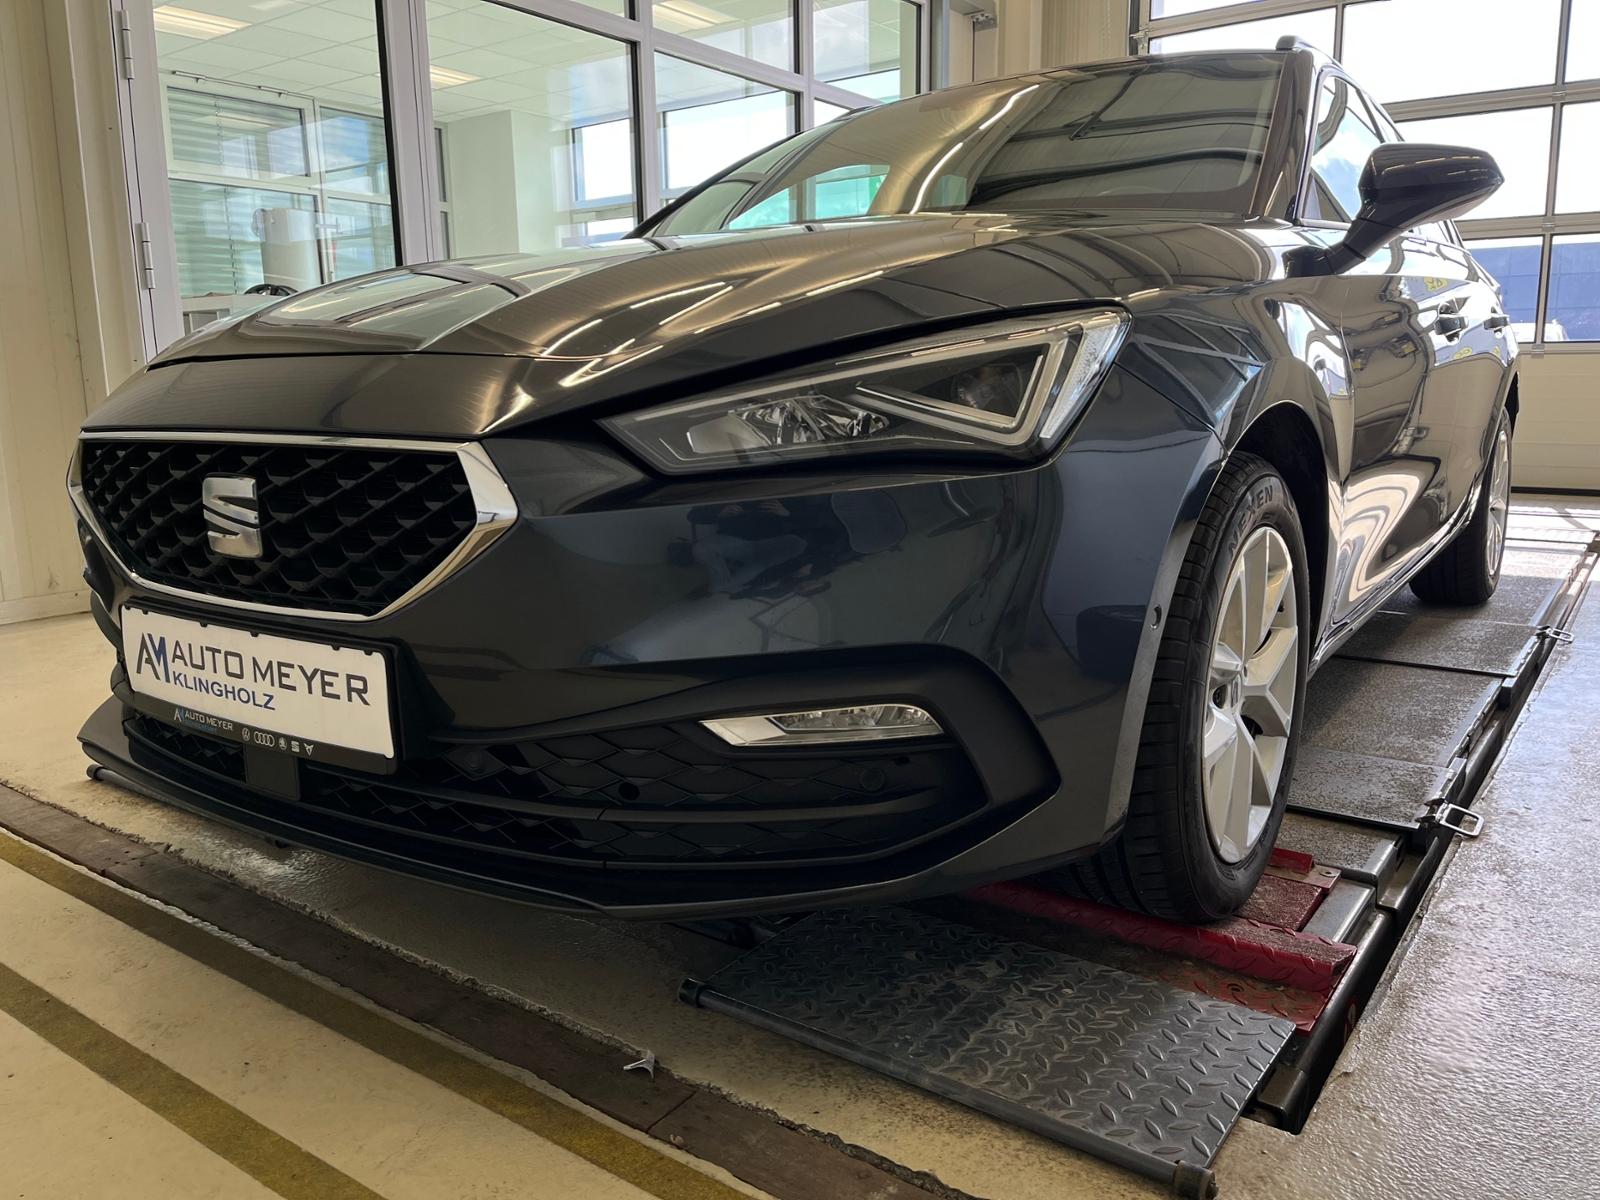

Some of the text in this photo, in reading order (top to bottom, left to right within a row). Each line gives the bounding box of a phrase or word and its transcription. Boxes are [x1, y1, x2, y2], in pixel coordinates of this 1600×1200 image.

[1228, 484, 1273, 557] NEXEN
[171, 639, 244, 680] AUTO
[252, 655, 371, 706] MEYER
[172, 671, 276, 711] KLINGHOLZ
[184, 710, 205, 724] AUTO
[205, 716, 233, 731] MEYER
